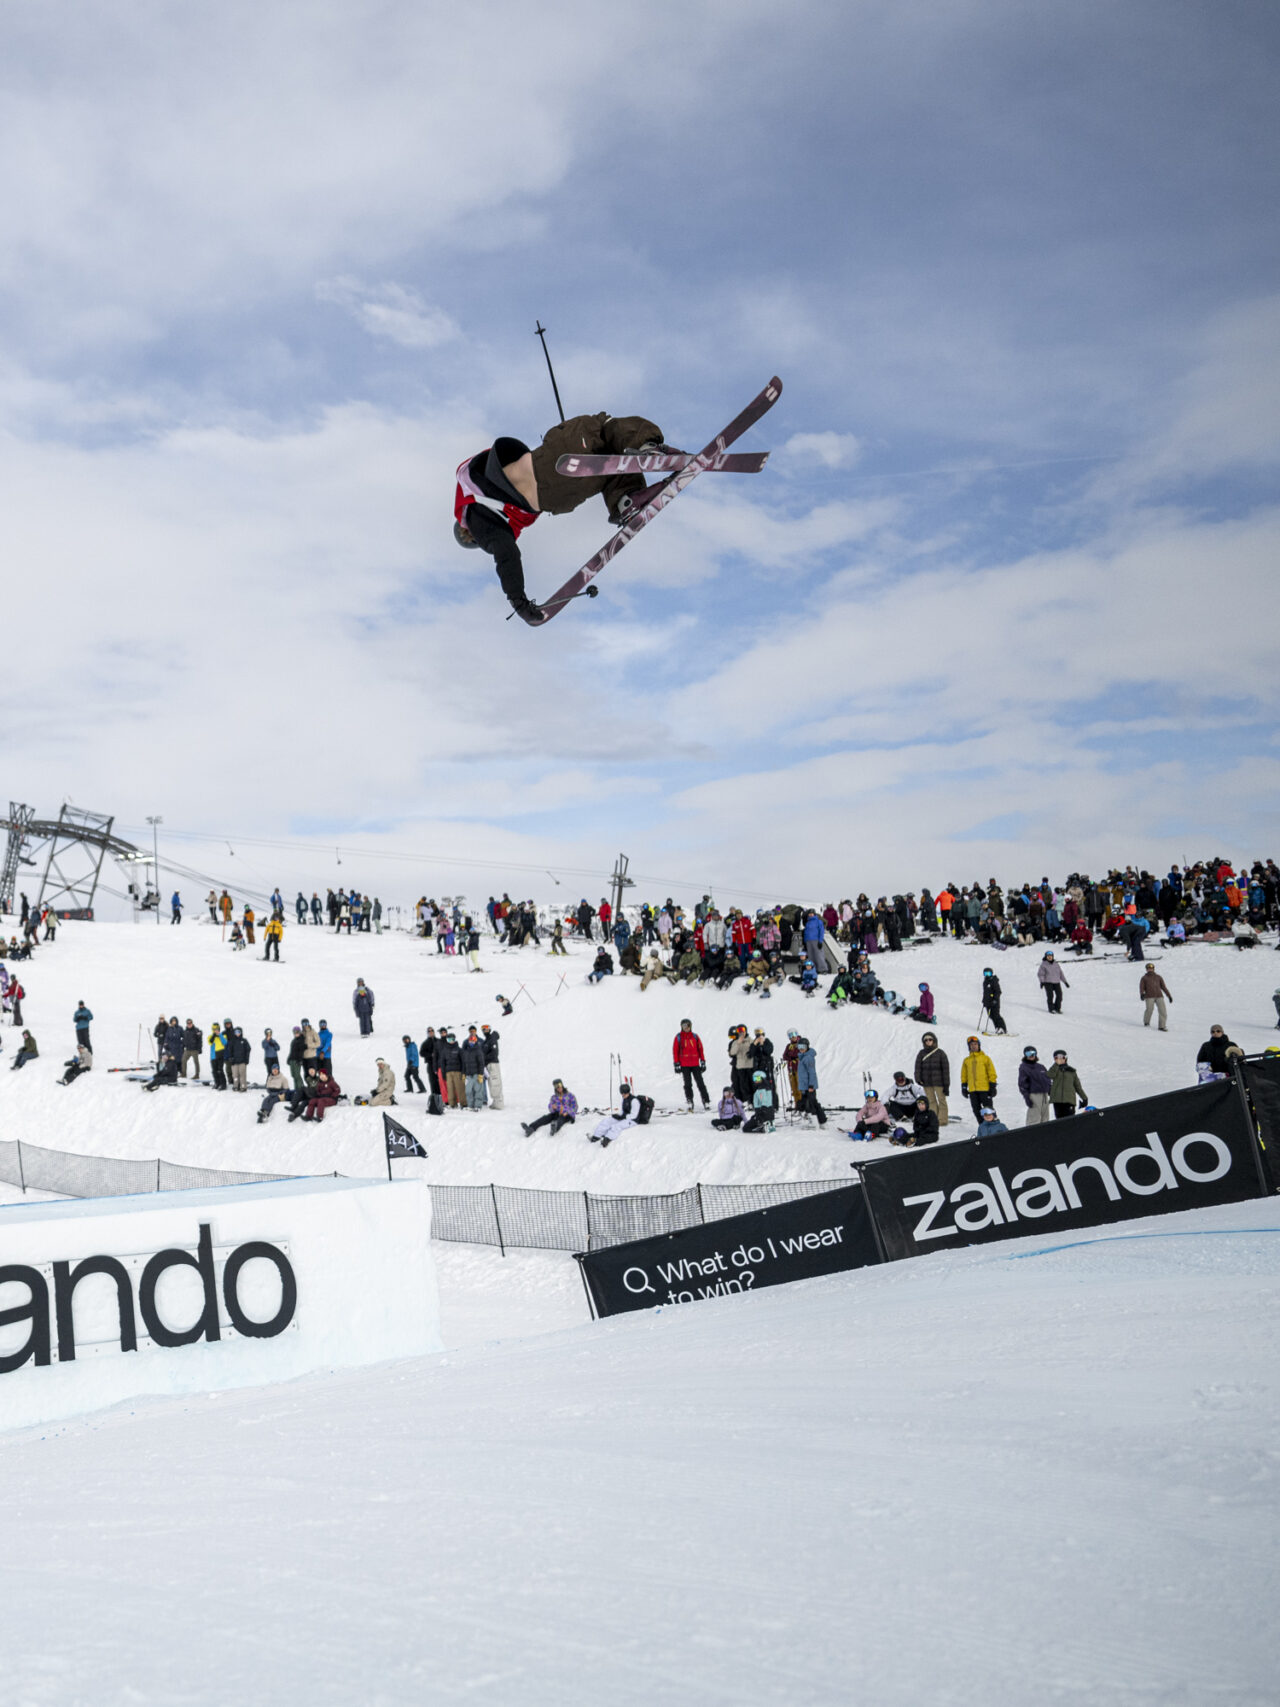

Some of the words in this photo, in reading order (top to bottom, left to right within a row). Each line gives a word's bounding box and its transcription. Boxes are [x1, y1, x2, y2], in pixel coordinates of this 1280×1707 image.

[902, 1131, 1233, 1242] zalando
[656, 1252, 728, 1284] What
[731, 1244, 765, 1267] do
[767, 1238, 778, 1258] I
[779, 1225, 844, 1255] wear
[667, 1290, 694, 1304] to
[697, 1270, 755, 1300] win?
